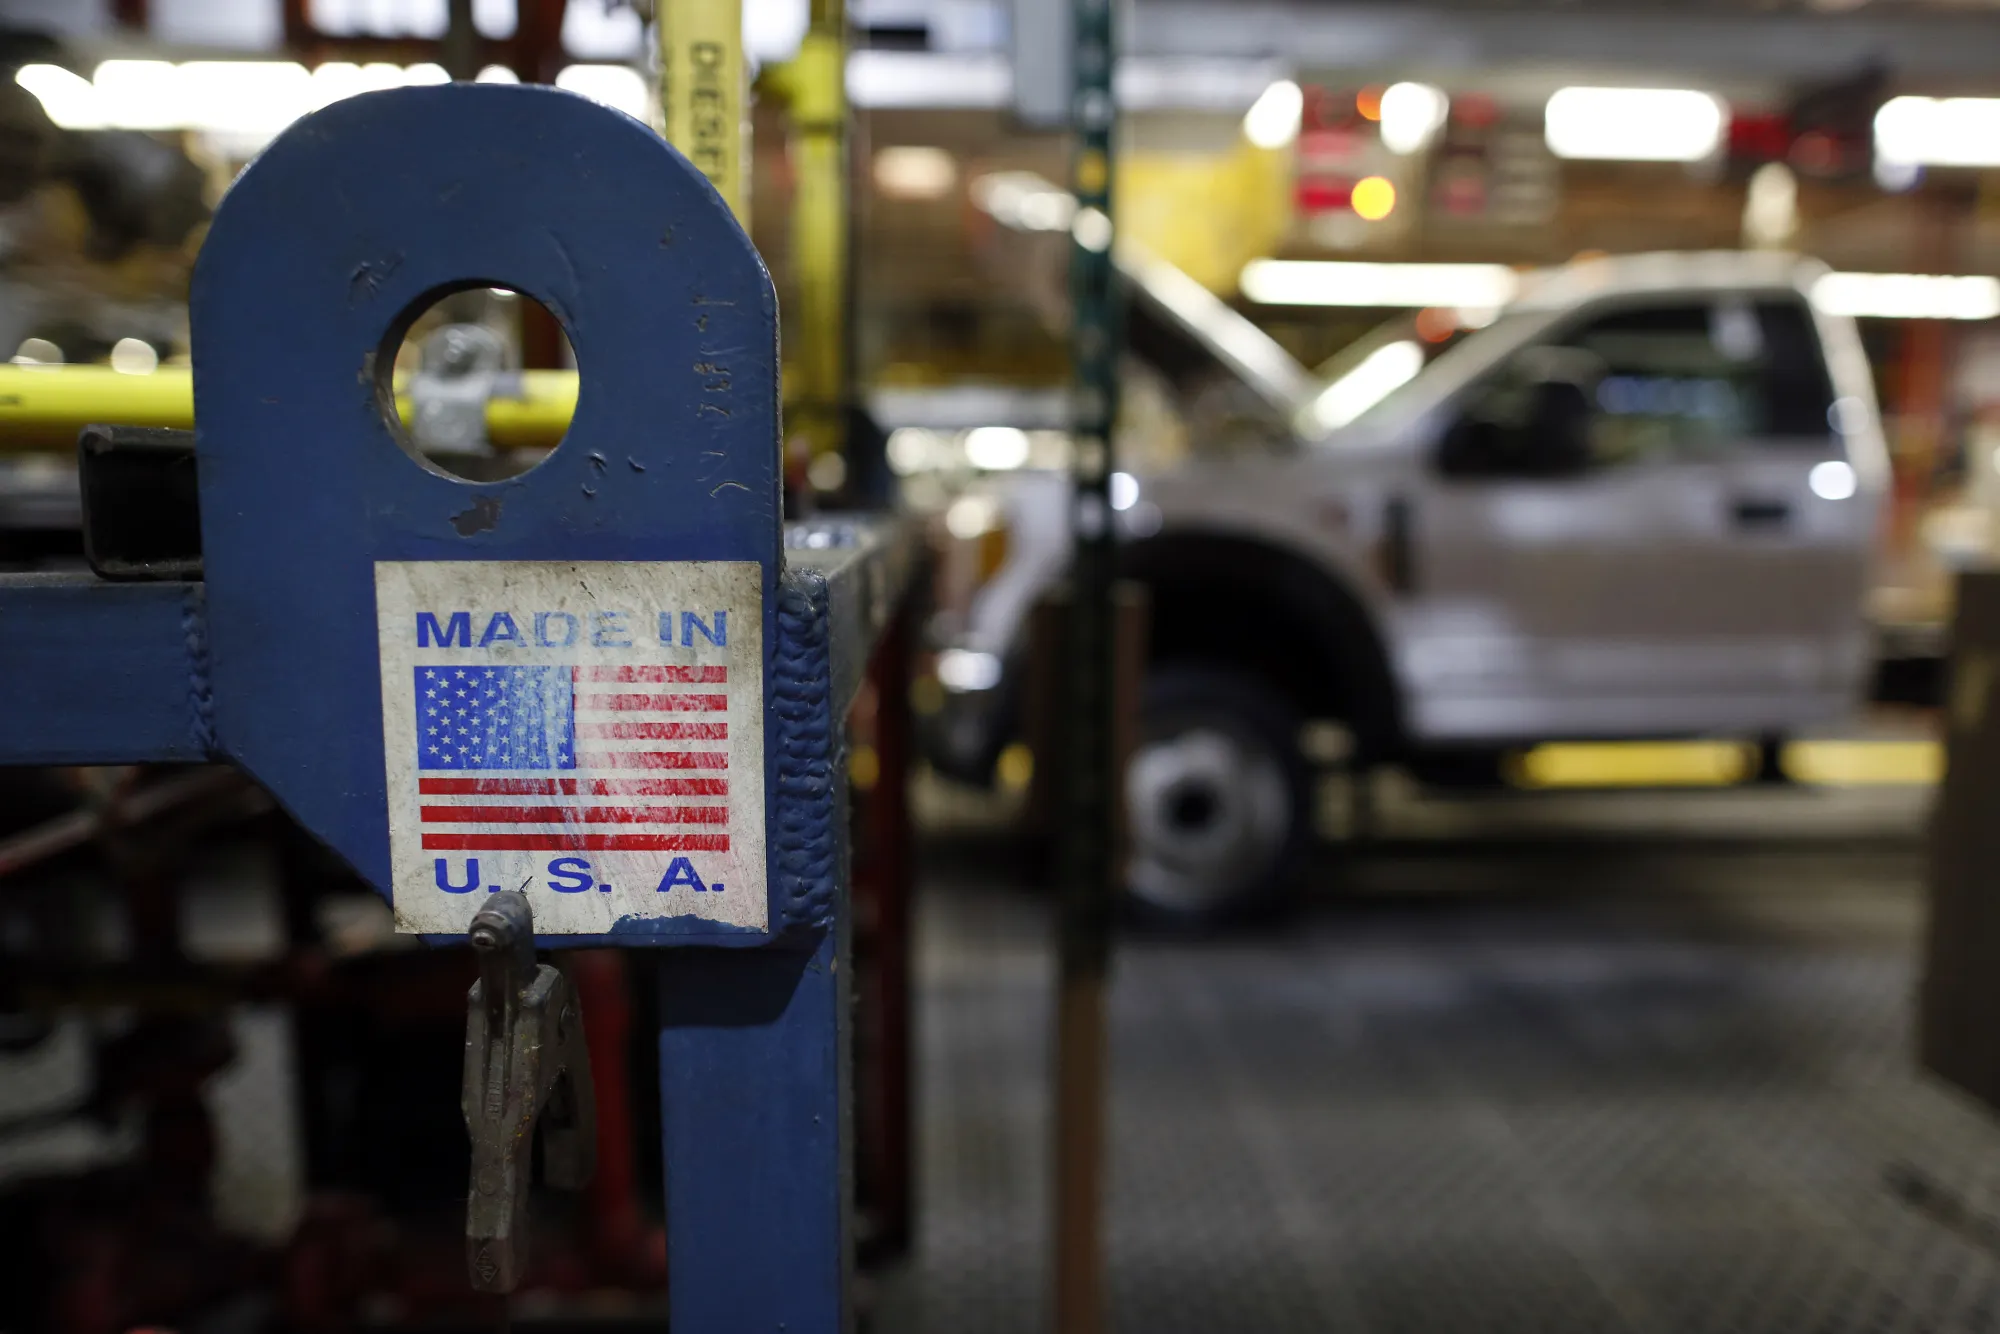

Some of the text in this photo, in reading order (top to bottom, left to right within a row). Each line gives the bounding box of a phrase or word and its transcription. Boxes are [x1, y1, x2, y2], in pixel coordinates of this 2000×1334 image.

[416, 611, 727, 648] MADE IN
[434, 857, 725, 894] U. S. A.
